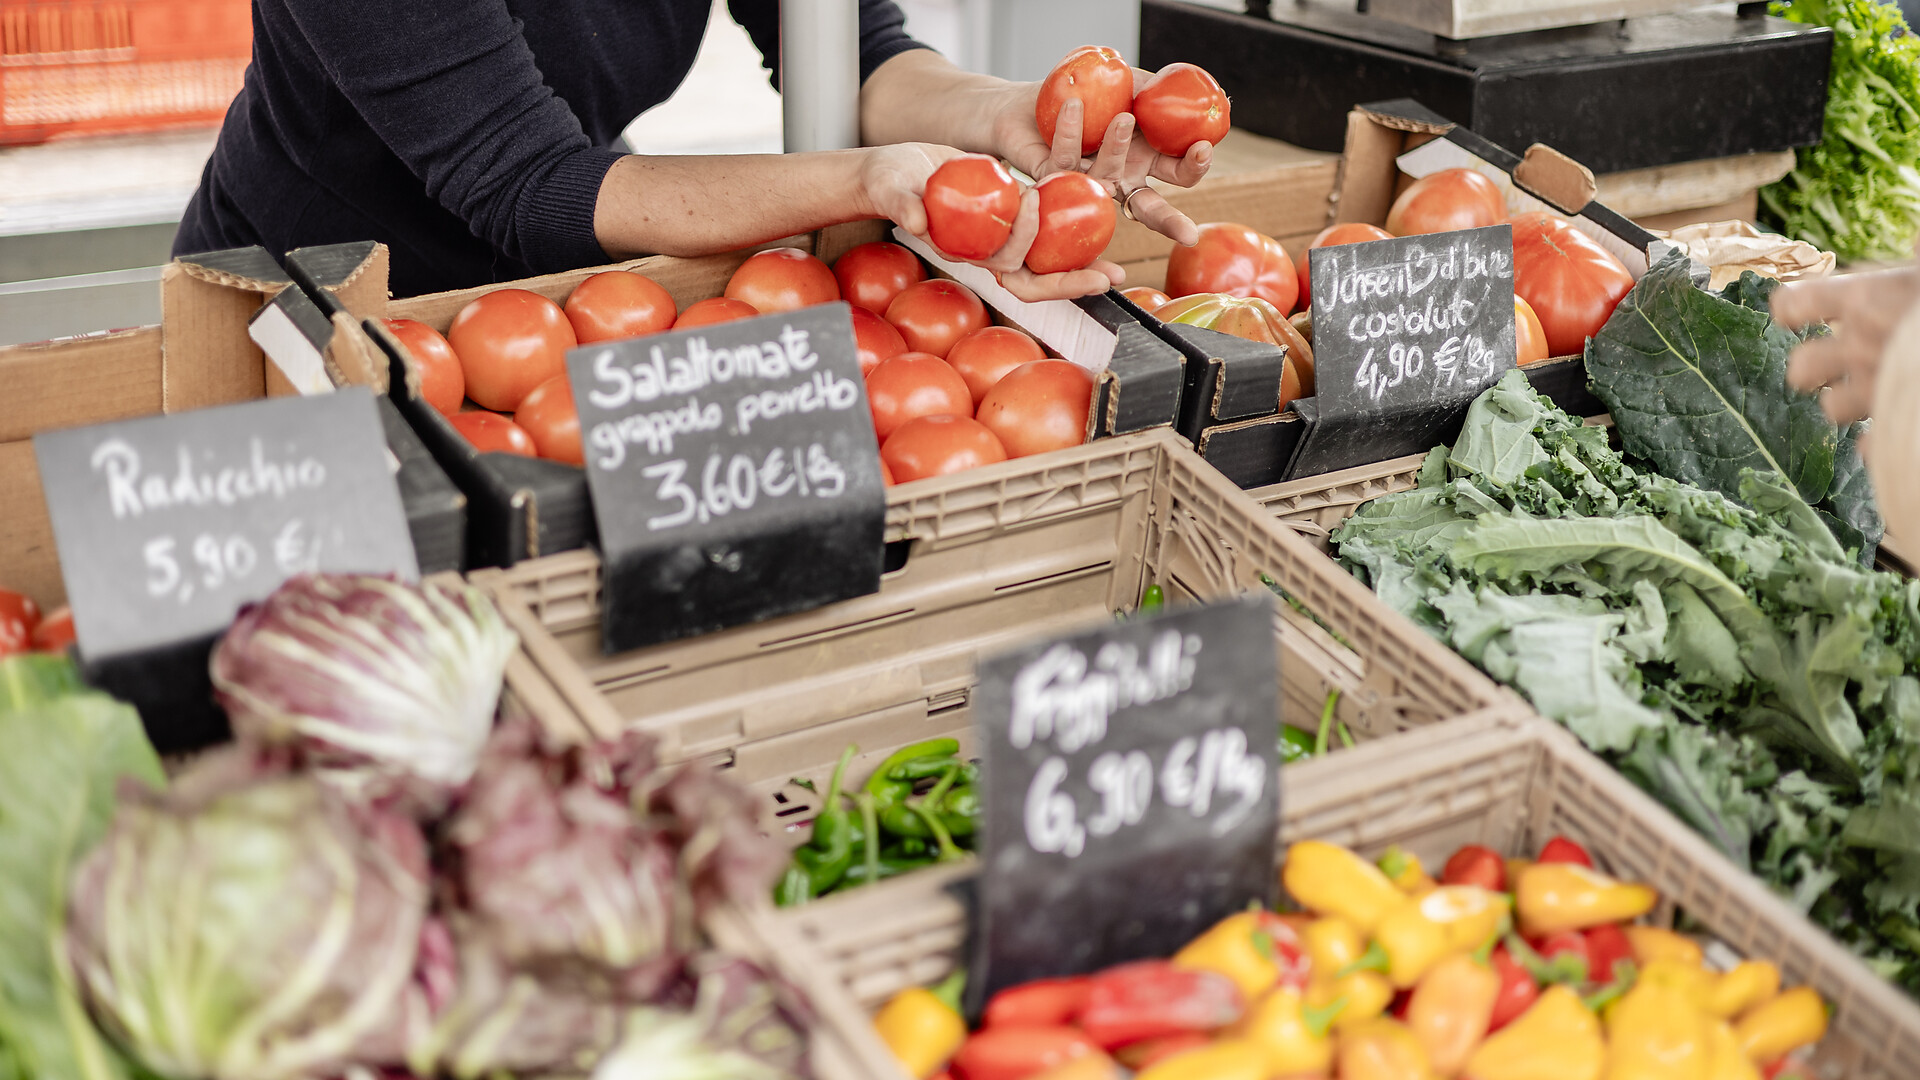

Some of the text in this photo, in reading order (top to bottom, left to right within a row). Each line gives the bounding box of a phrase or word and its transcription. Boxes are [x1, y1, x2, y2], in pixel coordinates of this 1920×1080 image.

[1355, 342, 1425, 401] 4,90
[590, 396, 723, 470] grappolo
[90, 436, 327, 518] Radicchio
[143, 532, 258, 605] 5,90
[1023, 749, 1154, 859] 6,90
